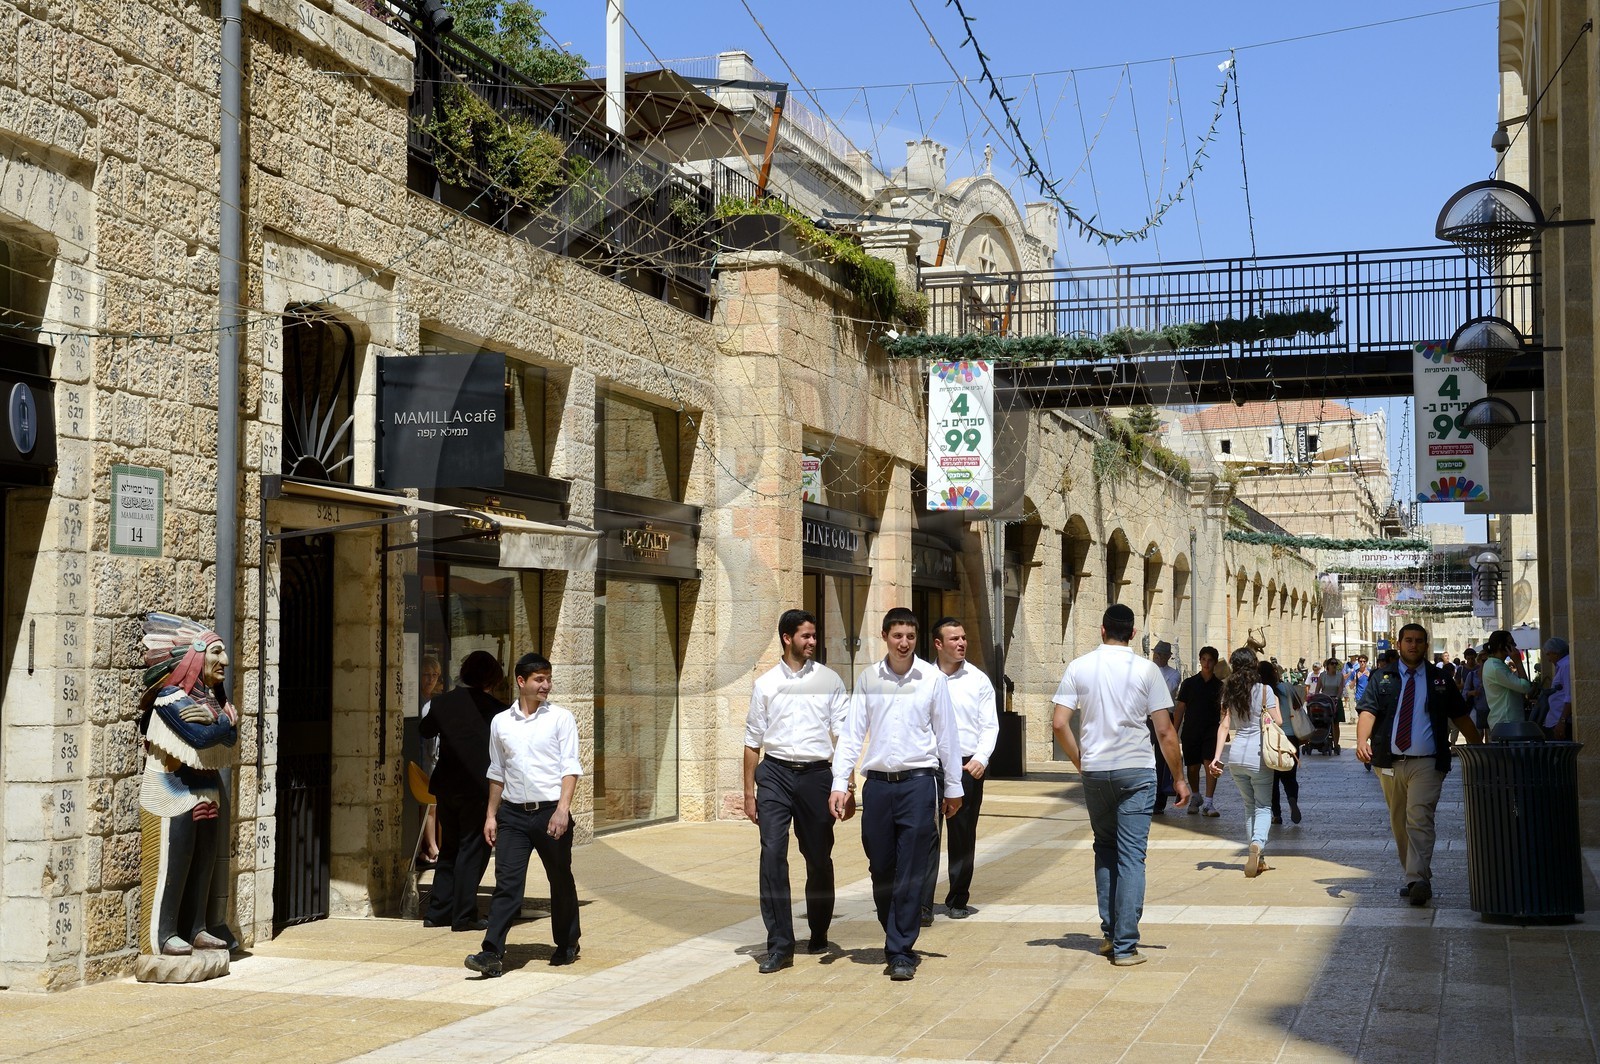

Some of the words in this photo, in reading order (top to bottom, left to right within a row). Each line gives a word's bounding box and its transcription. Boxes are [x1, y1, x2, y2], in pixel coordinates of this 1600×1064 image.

[74, 306, 80, 318] R
[264, 331, 279, 350] S25
[267, 351, 273, 364] L
[76, 361, 82, 372] R
[264, 377, 275, 389] D6
[1438, 374, 1461, 400] 4
[68, 392, 80, 403] D5
[262, 391, 279, 404] S26
[950, 393, 969, 417] 4
[1440, 402, 1473, 412] פרים
[68, 405, 84, 420] S27
[394, 410, 463, 425] MAMILLA
[72, 421, 78, 433] R
[952, 417, 985, 427] ספרים
[264, 432, 275, 443] D6
[417, 428, 437, 439] קפה
[440, 426, 469, 437] ממילא
[945, 429, 982, 452] 99
[264, 445, 277, 457] S27
[121, 480, 142, 494] ממילא
[69, 503, 80, 516] D5
[64, 516, 83, 536] S29
[131, 526, 143, 542] 14
[1393, 552, 1421, 561] ממילא
[63, 572, 82, 587] S30
[69, 592, 76, 605] R
[65, 622, 76, 633] D5
[63, 633, 77, 646] S31
[66, 652, 72, 664] R
[64, 675, 75, 686] D5
[63, 688, 79, 702] S32
[63, 732, 74, 743] D5
[61, 745, 78, 759] S33
[67, 762, 74, 773] R
[373, 772, 385, 785] S34
[62, 789, 73, 800] D5
[377, 788, 382, 798] R
[261, 796, 266, 806] L
[60, 801, 75, 814] S34
[64, 816, 70, 827] R
[259, 822, 267, 832] D6
[61, 846, 72, 856] D5
[262, 853, 267, 864] L
[58, 858, 75, 872] S35
[63, 873, 69, 885] R
[59, 902, 69, 914] D5
